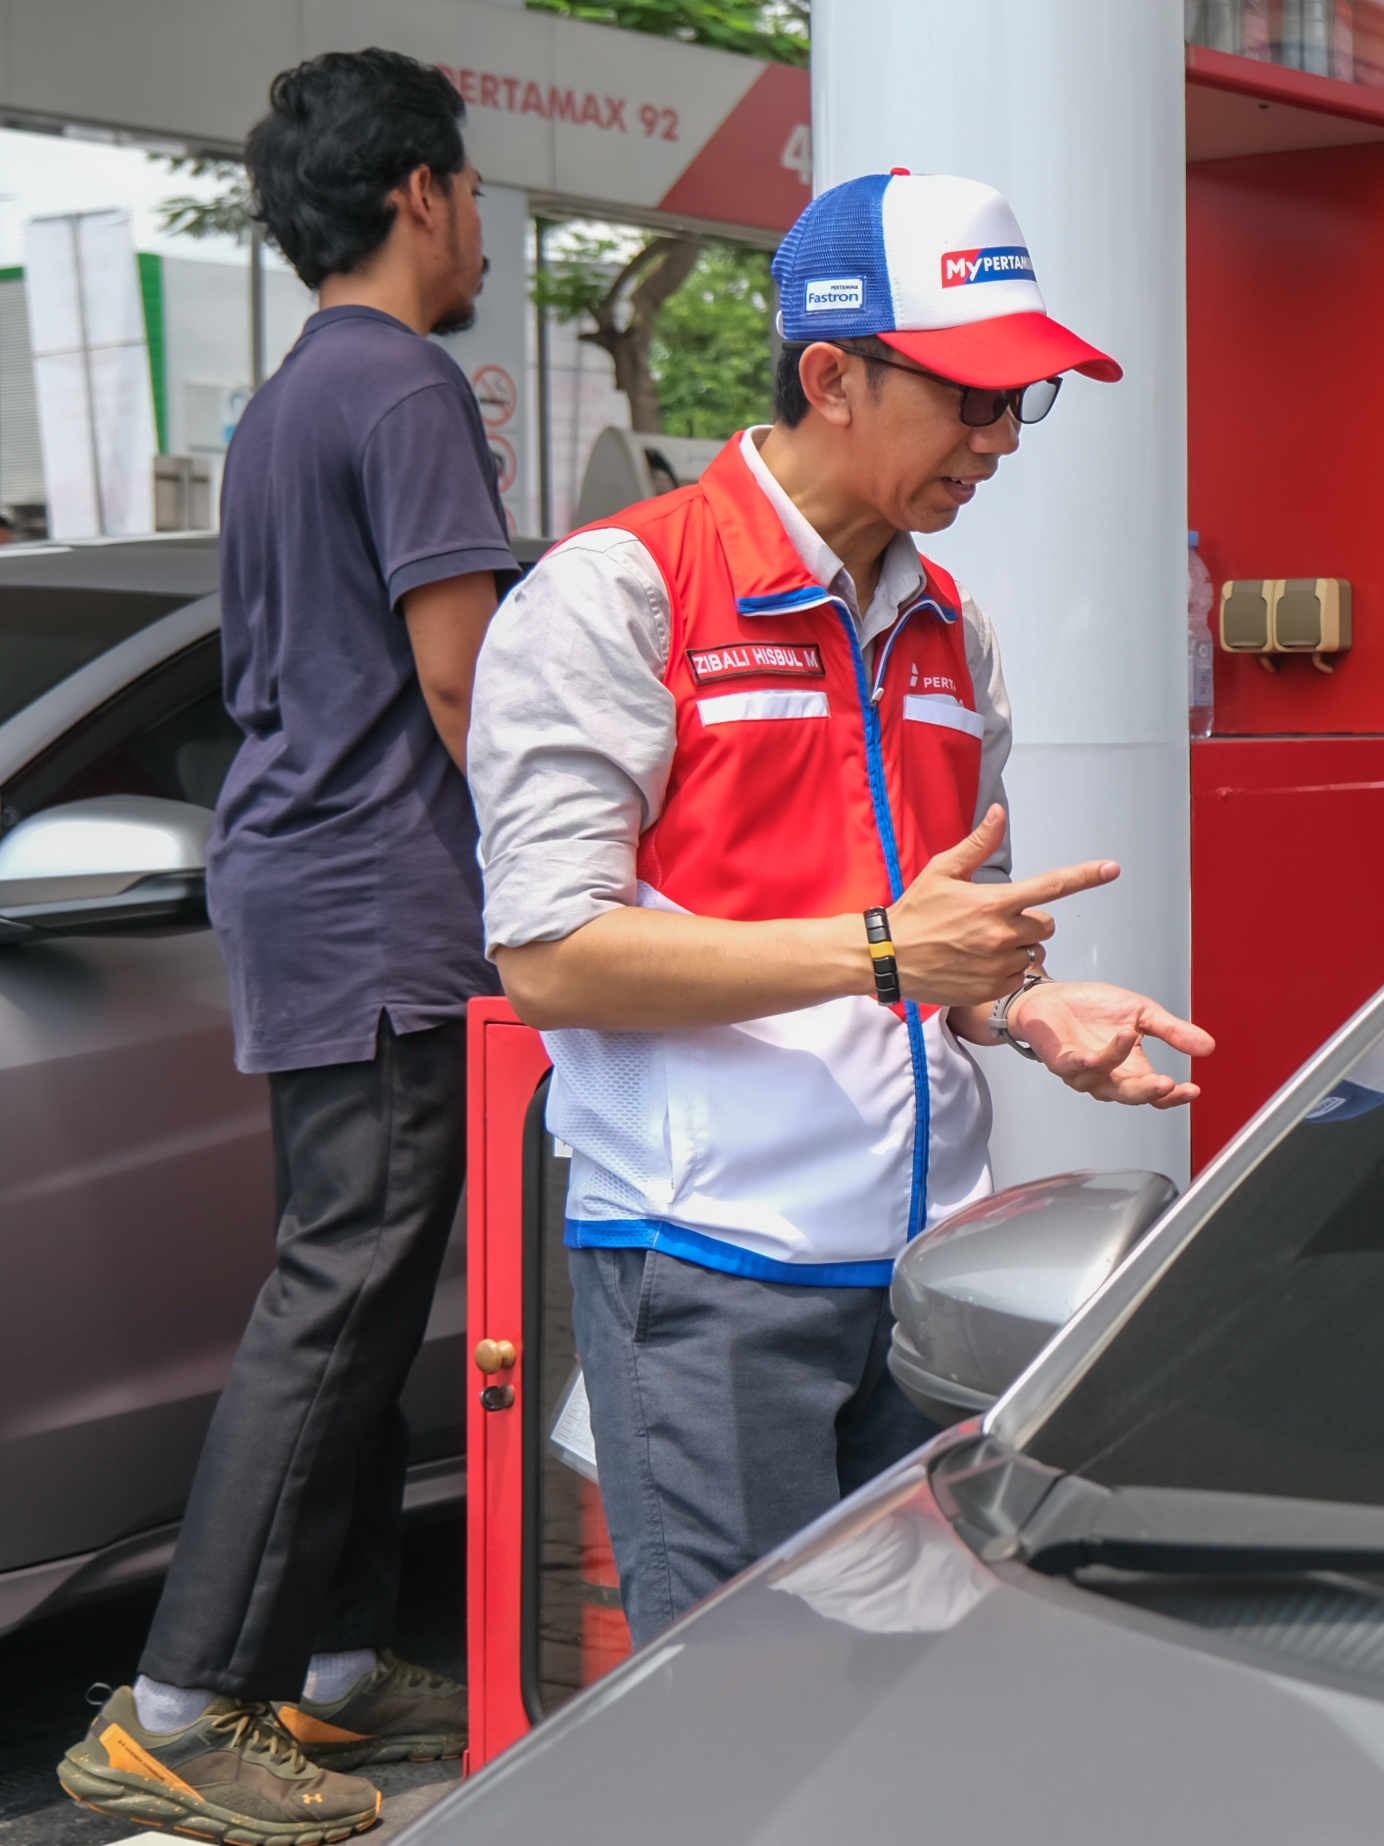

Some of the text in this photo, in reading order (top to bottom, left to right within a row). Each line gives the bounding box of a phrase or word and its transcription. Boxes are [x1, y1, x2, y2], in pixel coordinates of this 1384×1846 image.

[638, 103, 680, 142] 92
[780, 124, 812, 185] 4
[808, 292, 859, 304] Fastron
[692, 648, 819, 674] ZIBALI HISBUL M
